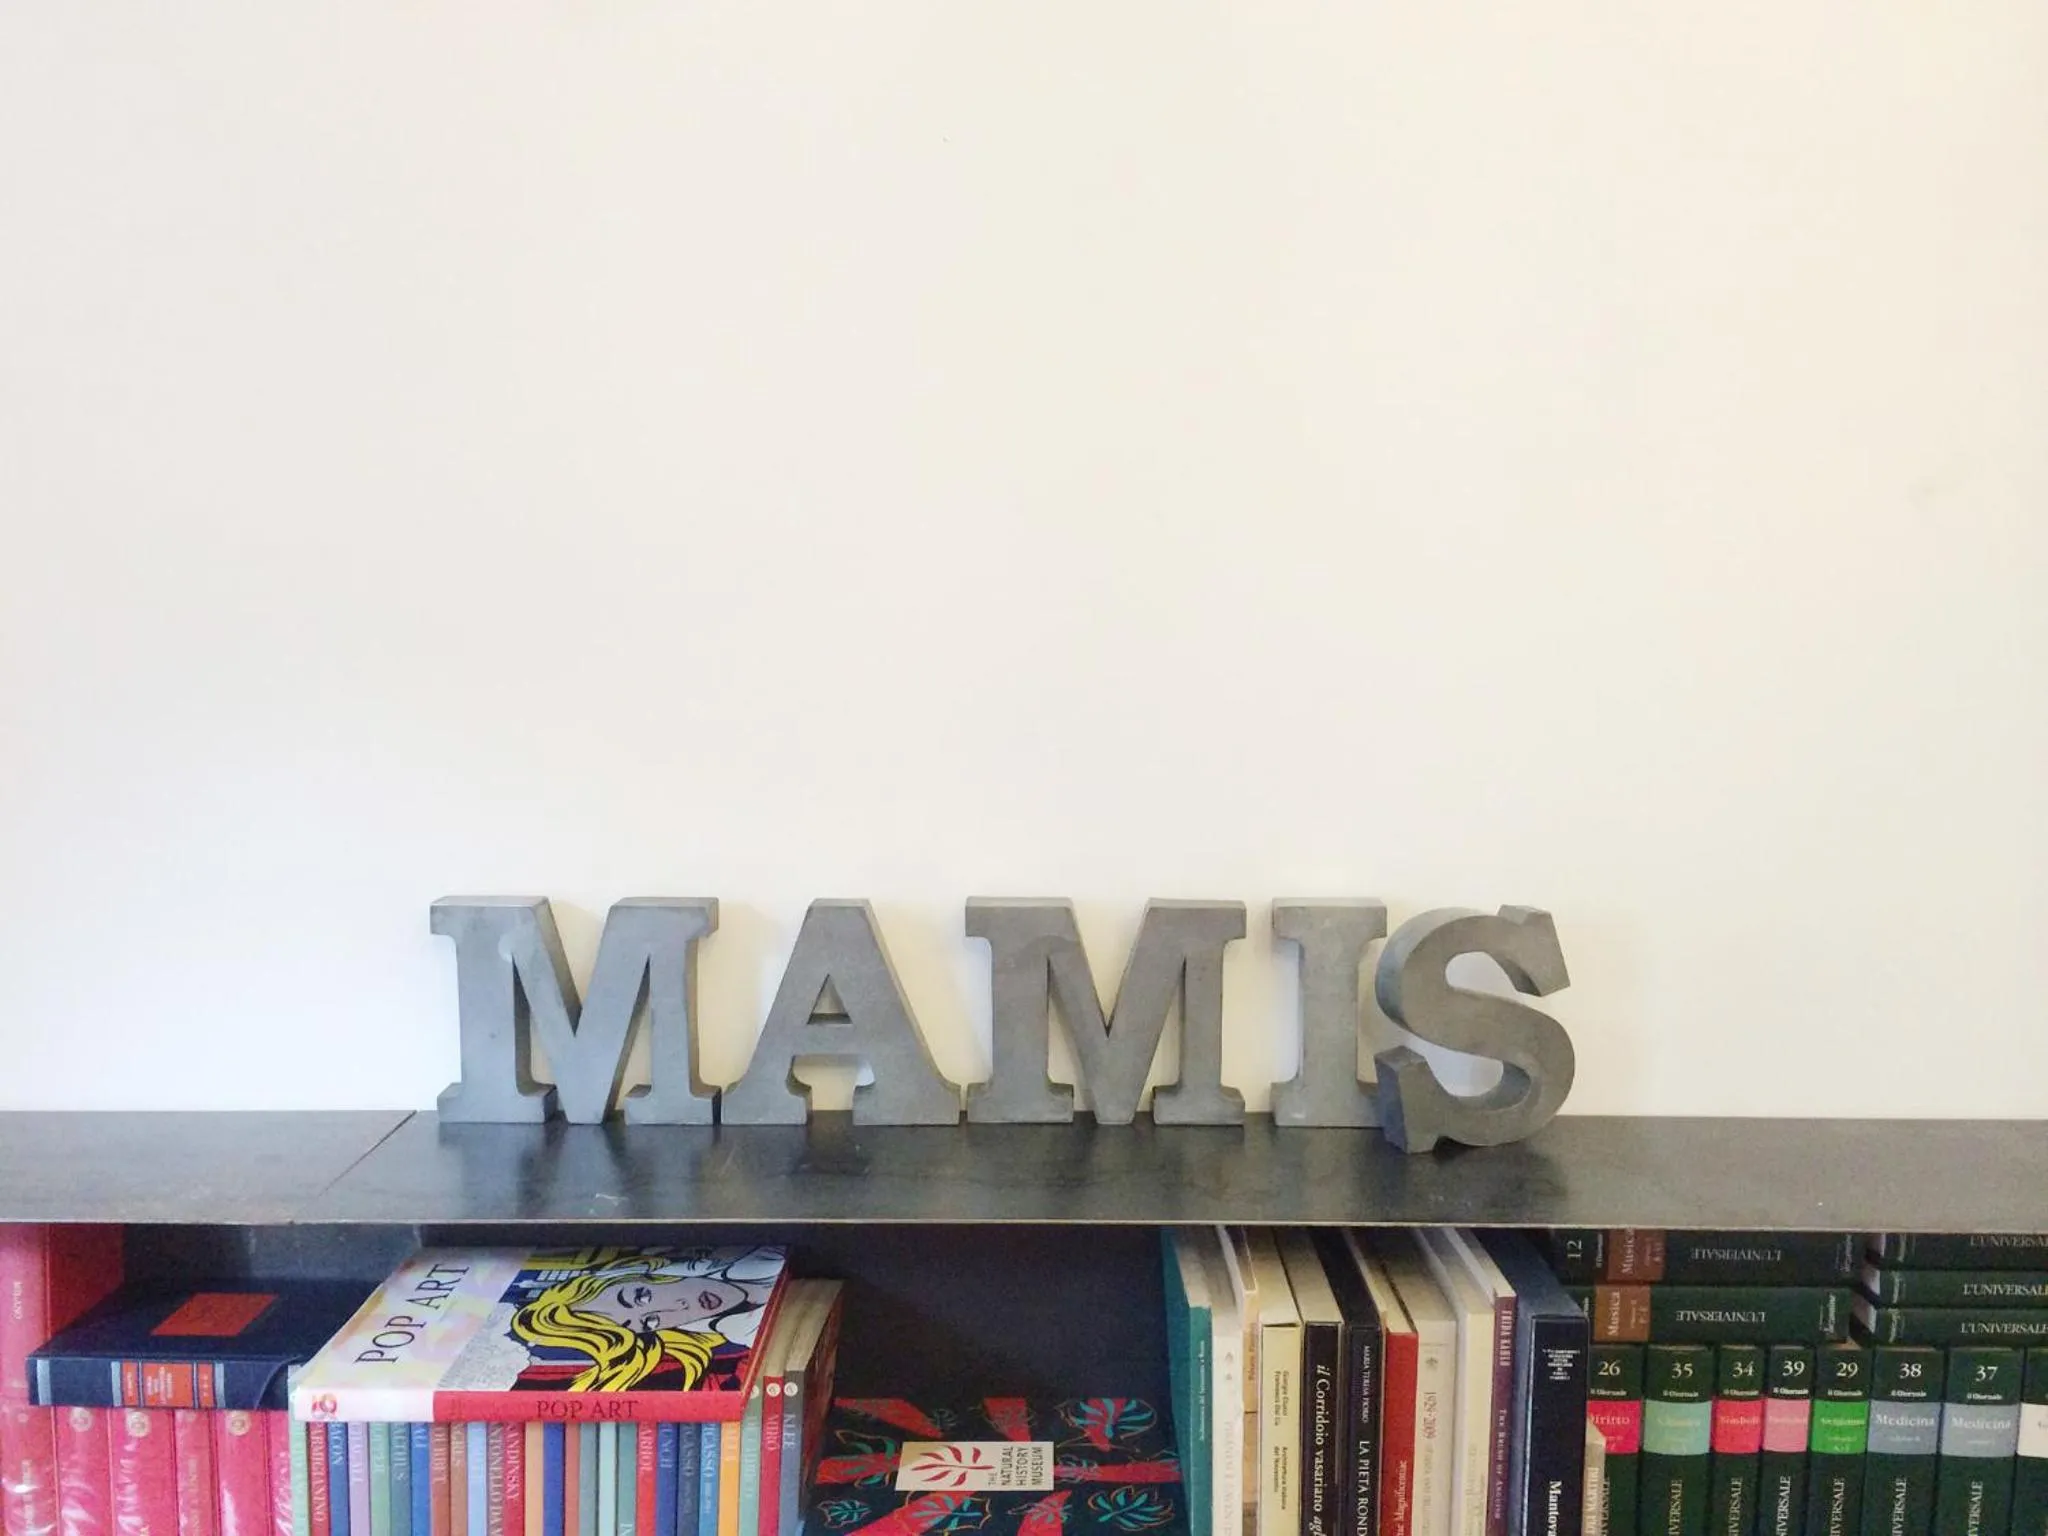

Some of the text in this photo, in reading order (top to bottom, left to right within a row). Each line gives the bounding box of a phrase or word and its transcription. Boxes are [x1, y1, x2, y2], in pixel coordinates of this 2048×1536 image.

[430, 895, 1575, 1153] MAMIS
[1567, 1239, 1582, 1259] 12
[1621, 1228, 1636, 1274] Musica
[354, 1263, 469, 1364] POP ART
[1606, 1291, 1621, 1336] Musica
[1676, 1310, 1767, 1323] L'UNIVERSALE
[1499, 1309, 1513, 1366] FRIDA KAHLO
[1362, 1345, 1371, 1369] MARIA
[1598, 1360, 1621, 1376] 26
[1731, 1361, 1754, 1378] 34
[1782, 1360, 1805, 1377] 39
[1836, 1361, 1859, 1378] 29
[1316, 1364, 1331, 1376] il
[1671, 1362, 1693, 1378] 35
[1899, 1362, 1922, 1378] 38
[1975, 1365, 1998, 1382] 37
[536, 1400, 638, 1418] POP ART
[1314, 1378, 1331, 1445] Corridoio
[1875, 1413, 1935, 1427] Medicina
[783, 1413, 796, 1450] KLEE
[1952, 1415, 2012, 1429] Medicina
[414, 1423, 426, 1448] ALI
[640, 1424, 654, 1472] ARHOL
[660, 1424, 673, 1469] UNCH
[1358, 1440, 1370, 1454] LA
[432, 1425, 447, 1484] OURBET
[682, 1423, 695, 1477] ICASSO
[1001, 1446, 1014, 1486] NATURAL
[1016, 1446, 1028, 1486] HISTORY
[1032, 1446, 1043, 1486] MUSEUM
[1312, 1449, 1325, 1512] vasariano
